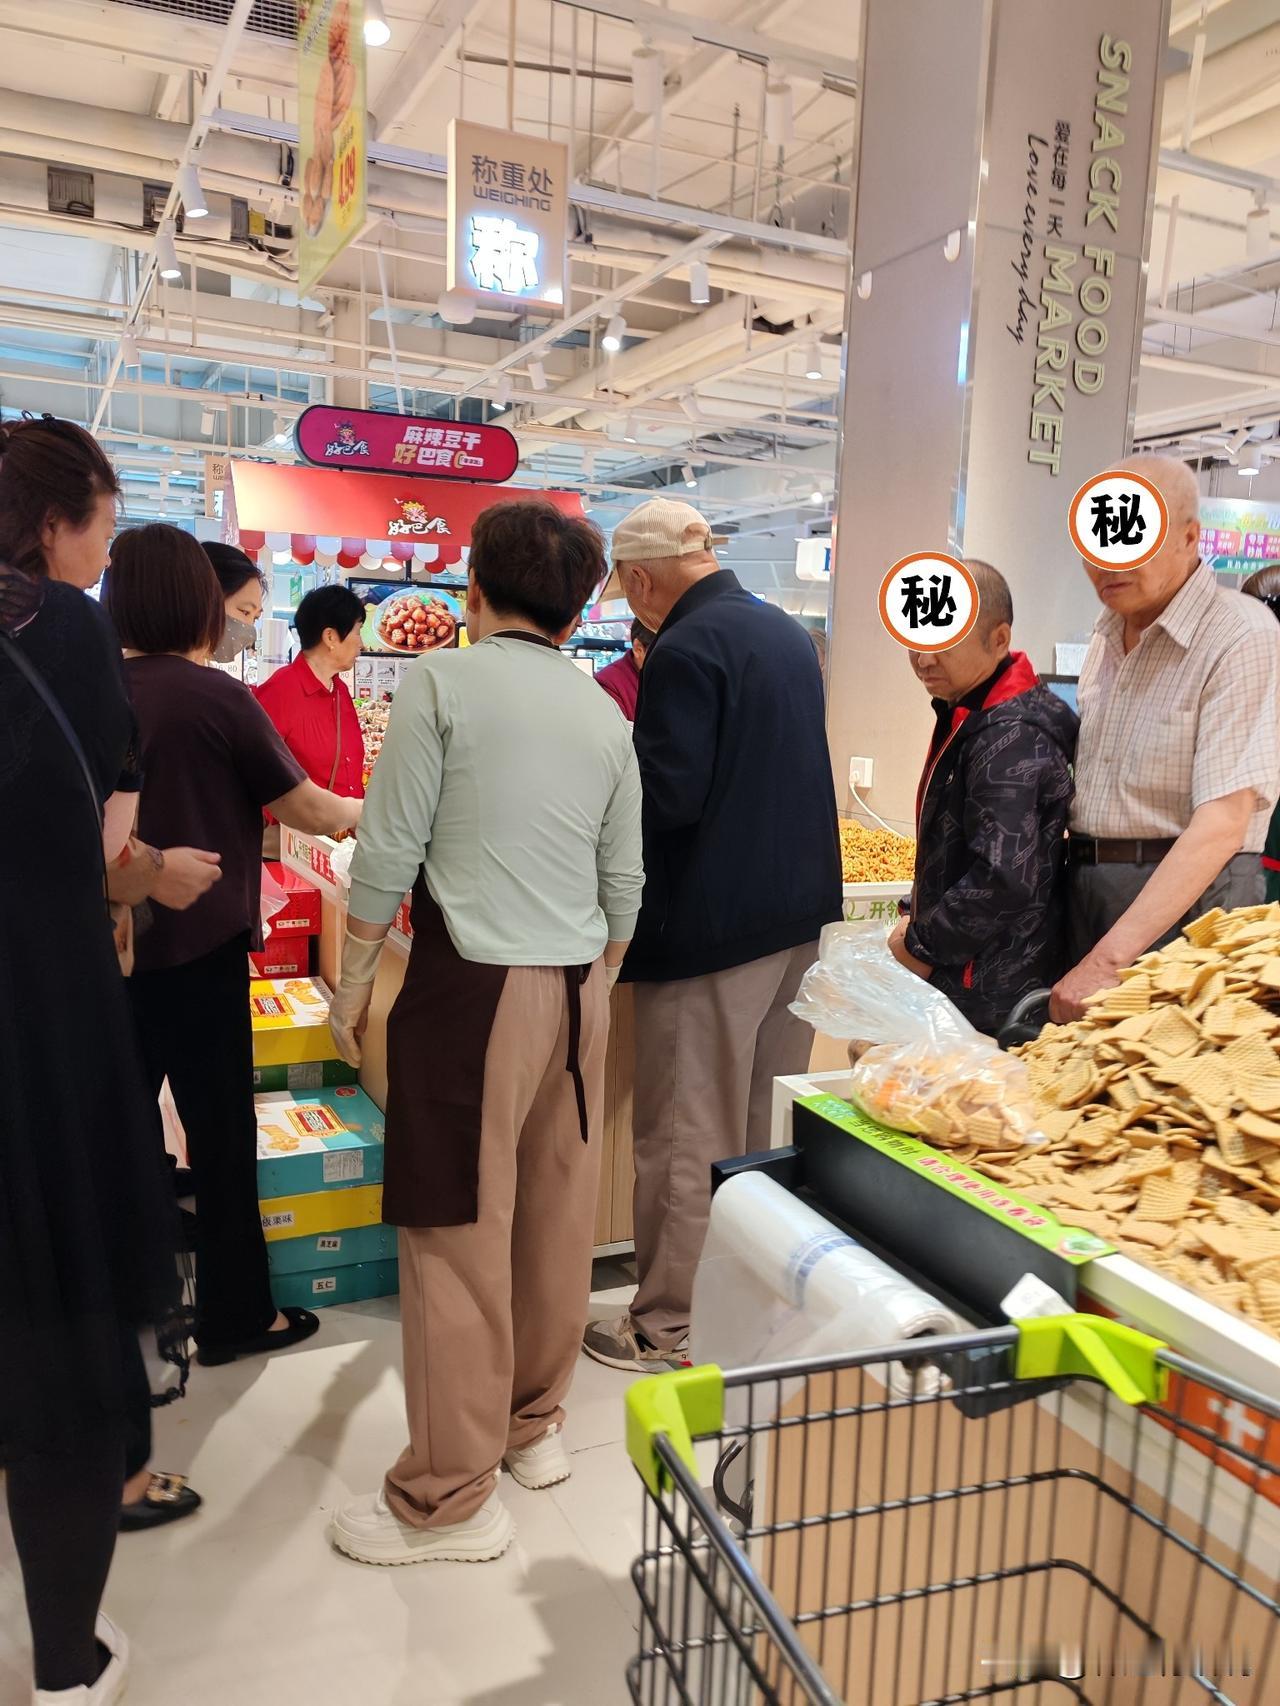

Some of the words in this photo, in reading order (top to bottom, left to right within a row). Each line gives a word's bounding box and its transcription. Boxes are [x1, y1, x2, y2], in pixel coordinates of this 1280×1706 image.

[1086, 34, 1132, 233] SNACK
[472, 154, 553, 197] 称重处
[1026, 132, 1049, 199] Love
[1047, 120, 1070, 238] 爱在每一天
[473, 186, 552, 213] WEIGHING
[470, 215, 539, 294] 称
[1007, 286, 1037, 345] day
[1072, 244, 1116, 396] FOOD
[1028, 244, 1077, 477] MARKET
[391, 443, 453, 468] 好巴食
[402, 425, 482, 451] 麻辣豆干
[316, 1280, 334, 1290] 五仁
